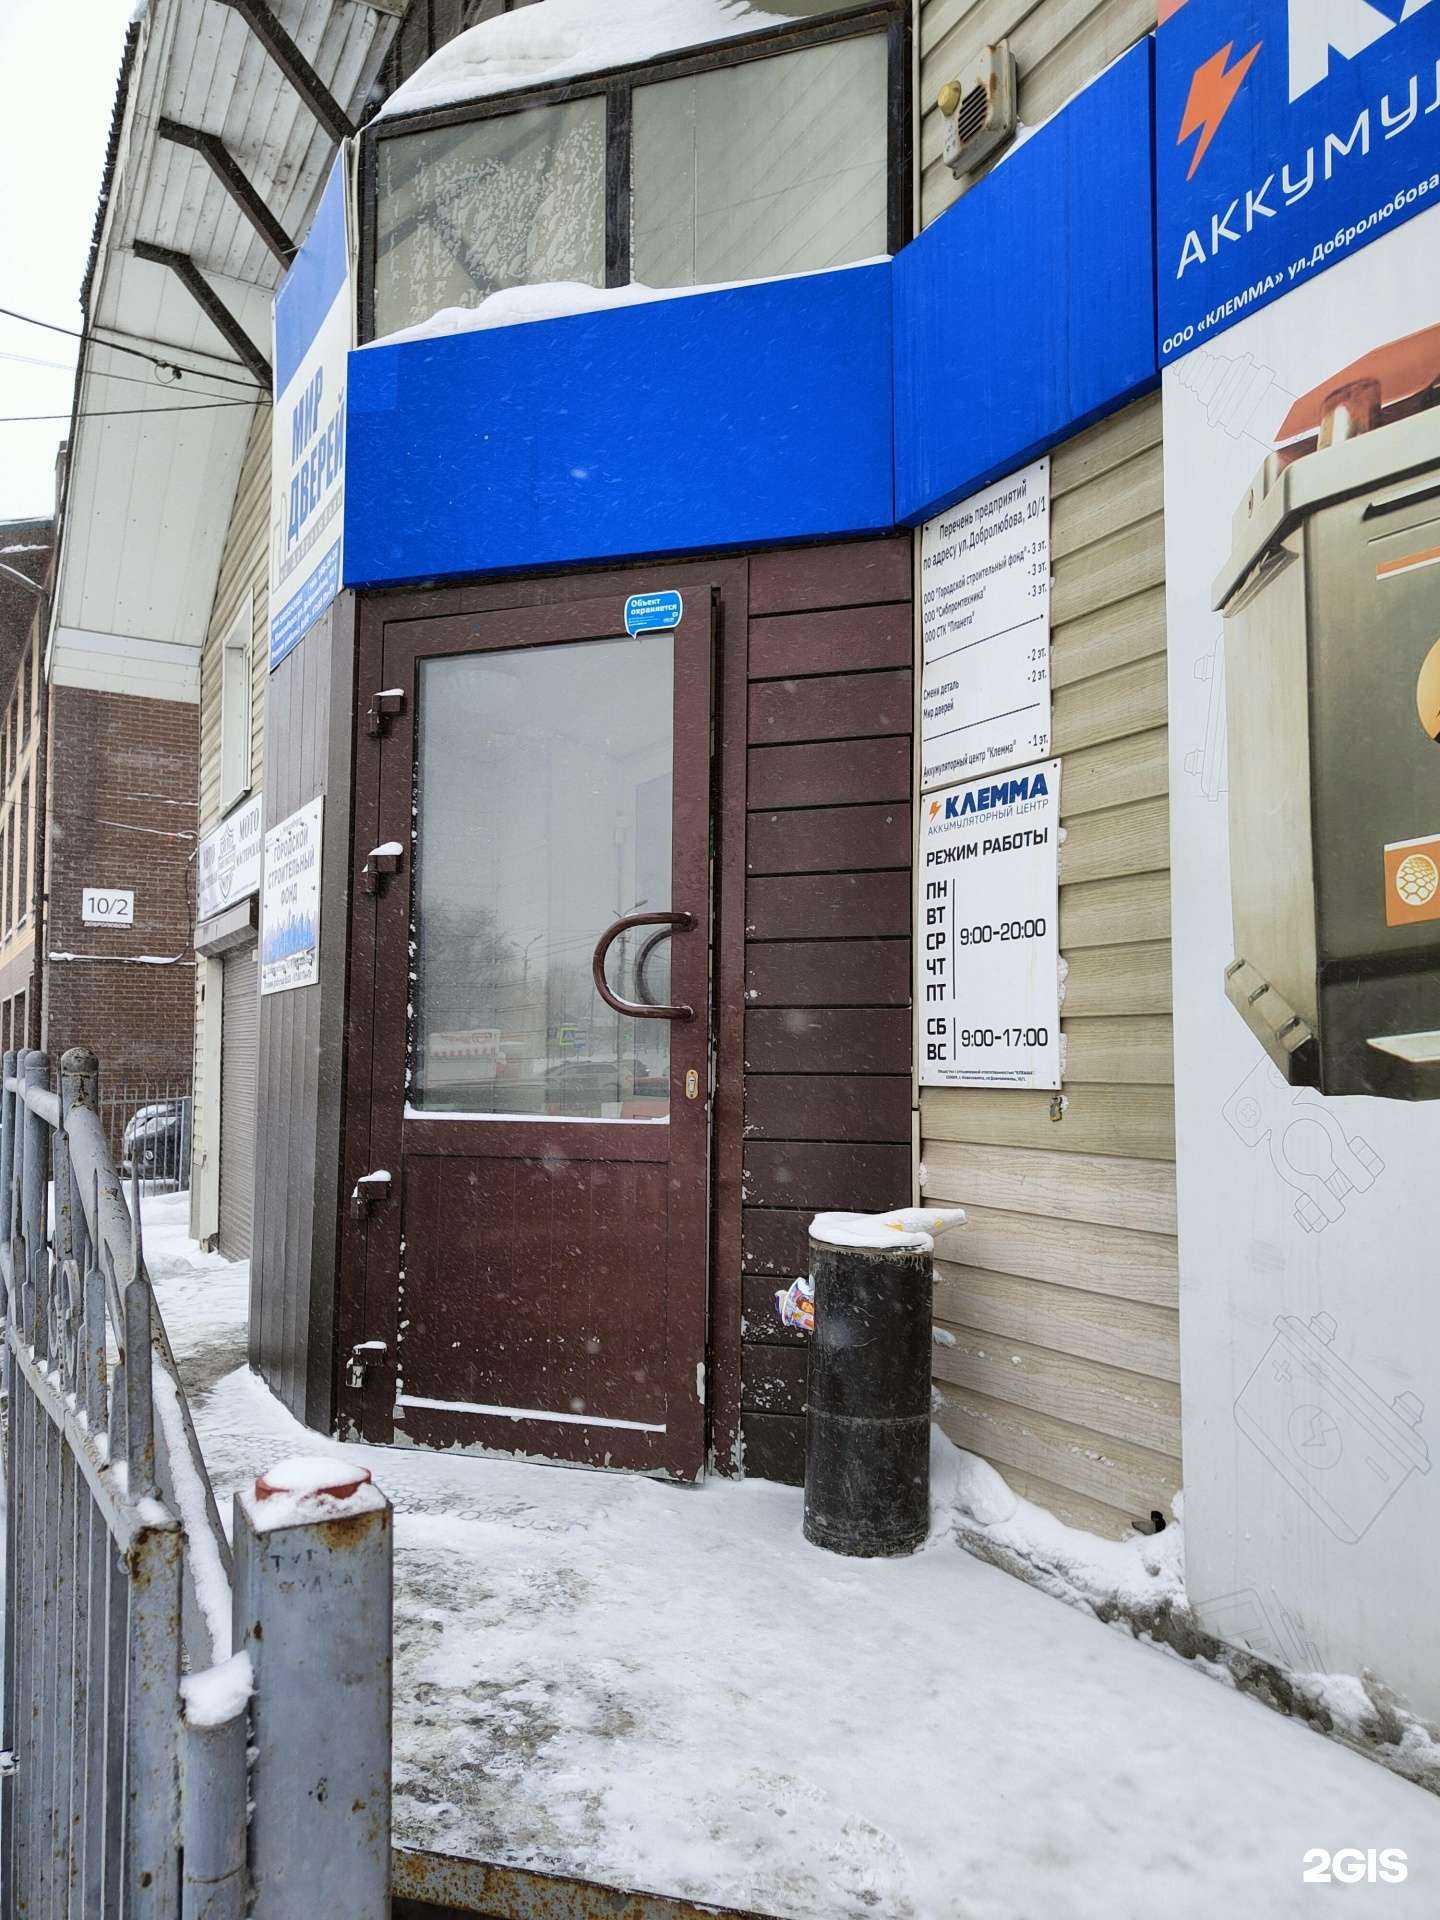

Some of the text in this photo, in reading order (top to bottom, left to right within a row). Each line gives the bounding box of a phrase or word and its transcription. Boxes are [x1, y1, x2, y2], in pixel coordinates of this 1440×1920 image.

[1162, 325, 1194, 354] ООО
[1197, 271, 1283, 333] «КЛЕММА»
[292, 365, 324, 467] МИР
[288, 386, 345, 551] ДВЕРЕЙ
[939, 483, 1027, 540] Перечень предприятий
[923, 557, 932, 570] по
[932, 546, 957, 569] адресу
[1027, 496, 1046, 519] 10/1
[966, 555, 1007, 588] строительный
[631, 599, 661, 608] Объект
[631, 604, 677, 615] охраняется
[923, 707, 934, 720] Мир
[968, 750, 986, 767] центр
[945, 773, 1049, 820] КЛЕММА
[928, 798, 1049, 837] АККУМУЛЯТОРНЫЙ ЦЕНТР
[926, 827, 1048, 867] РЕЖИМ РАБОТЫ
[926, 880, 947, 900] ПН
[88, 897, 128, 915] 10/2
[926, 906, 946, 925] ВТ
[926, 918, 1046, 950] СР 9:00-20:00
[926, 957, 946, 975] ЧТ
[926, 984, 946, 1001] ПТ
[927, 1018, 1048, 1047] СБ 9:00-17:00
[927, 1043, 947, 1060] ВС
